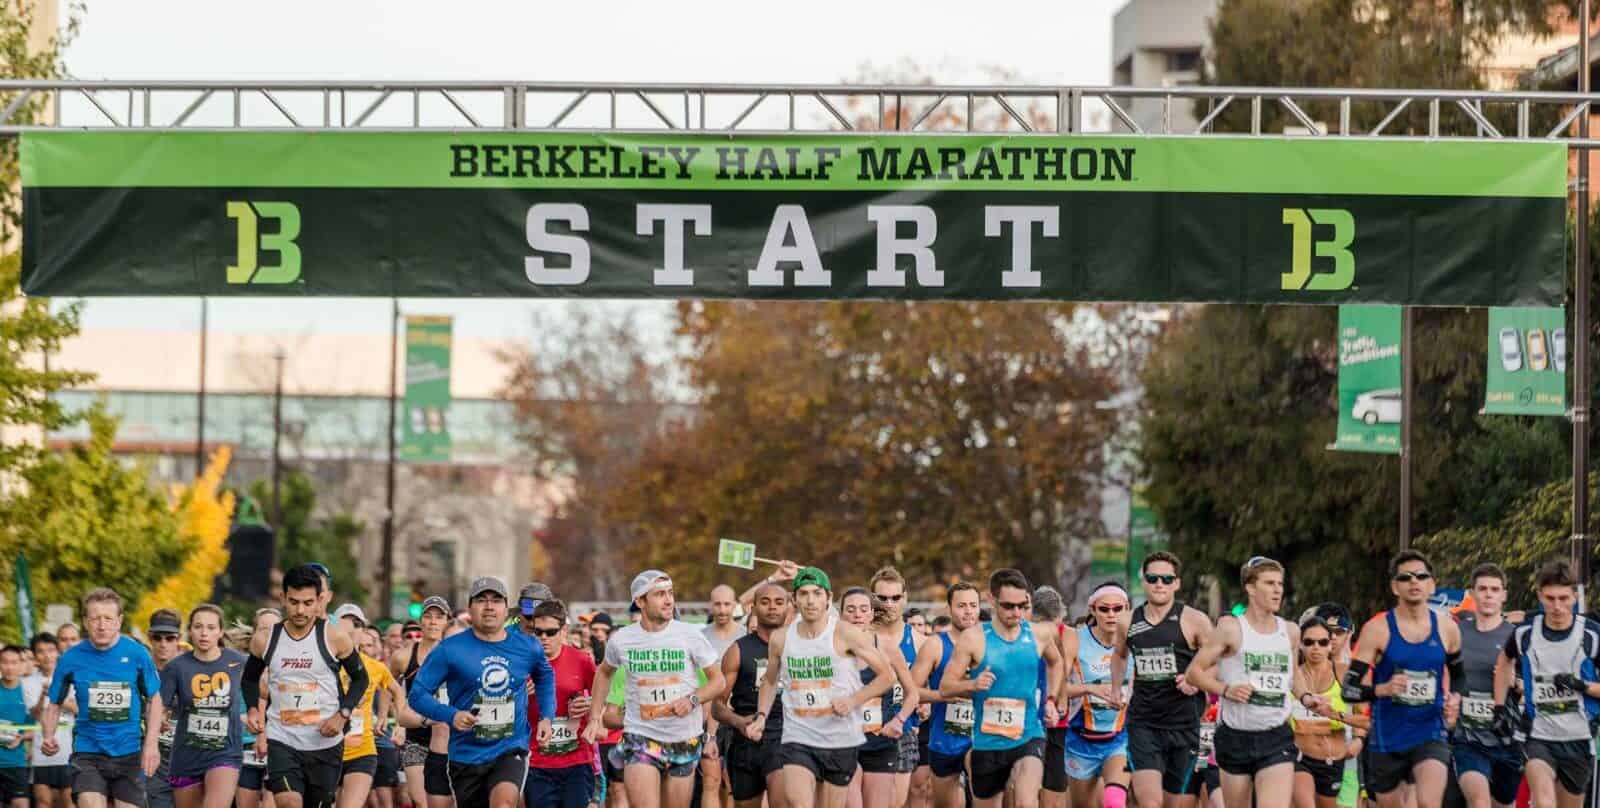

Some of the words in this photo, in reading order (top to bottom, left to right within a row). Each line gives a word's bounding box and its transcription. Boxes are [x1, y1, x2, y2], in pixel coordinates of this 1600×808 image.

[449, 144, 701, 182] BERKELEY
[715, 145, 842, 182] HALF
[857, 146, 1136, 183] MARATHON
[524, 202, 1060, 288] START
[628, 648, 660, 661] That's
[661, 648, 685, 661] Fine
[628, 660, 657, 672] Track
[660, 660, 685, 672] Club
[1139, 658, 1173, 671] 7115
[191, 671, 232, 697] GO
[1259, 674, 1283, 689] 152
[96, 692, 123, 705] 239
[293, 695, 302, 708] 7
[650, 689, 666, 702] 11
[806, 692, 815, 706] 9
[491, 707, 498, 721] 1
[995, 710, 1012, 723] 13
[195, 720, 220, 731] 144
